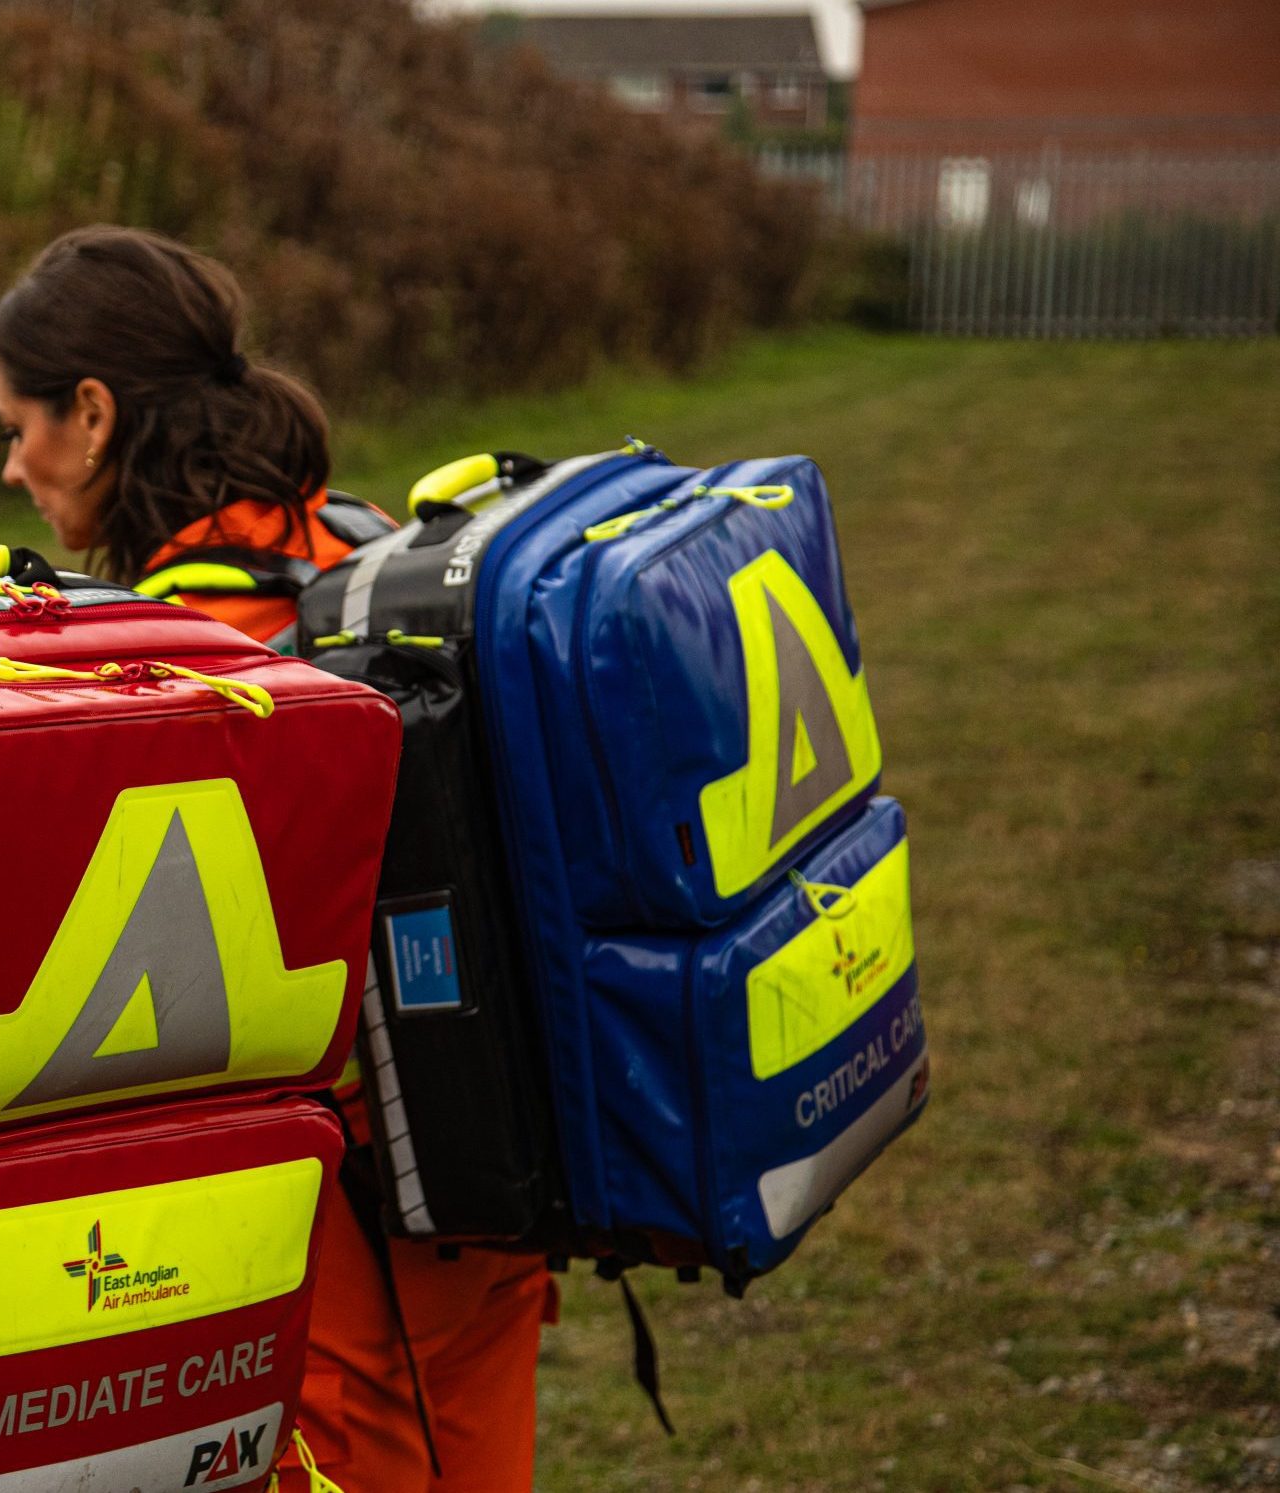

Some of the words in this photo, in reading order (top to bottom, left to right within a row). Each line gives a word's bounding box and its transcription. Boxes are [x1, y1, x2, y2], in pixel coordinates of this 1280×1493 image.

[796, 1034, 890, 1128] CRITICAL
[103, 1294, 121, 1311] Air
[122, 1283, 190, 1306] Ambulance
[104, 1275, 130, 1291] East
[132, 1265, 179, 1287] Anglian
[178, 1333, 277, 1397] CARE
[183, 1423, 268, 1488] PAX
